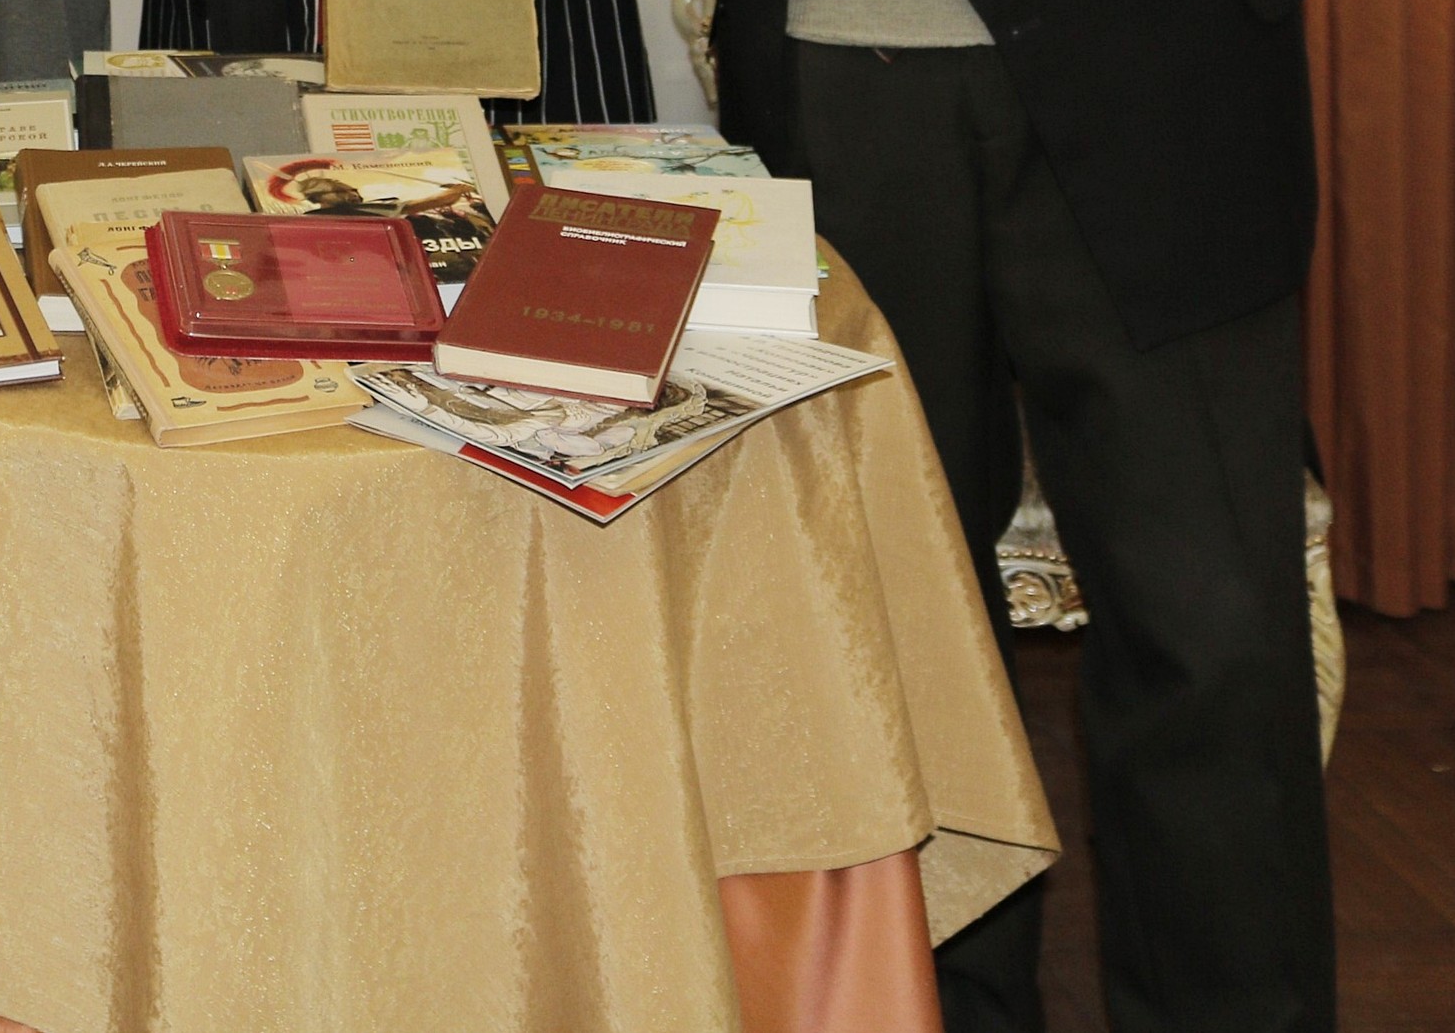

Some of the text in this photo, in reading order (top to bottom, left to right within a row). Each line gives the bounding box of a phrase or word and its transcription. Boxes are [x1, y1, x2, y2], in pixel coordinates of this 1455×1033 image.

[331, 108, 457, 121] СТИХОТВОРЕНИЯ
[539, 193, 694, 224] ПИСАТЕЛИ
[560, 231, 628, 246] СПРАВОЧНИК
[562, 225, 688, 248] БИОБИБЛИОГРАФИЧЕСКИЙ
[422, 237, 483, 254] ЗДЫ
